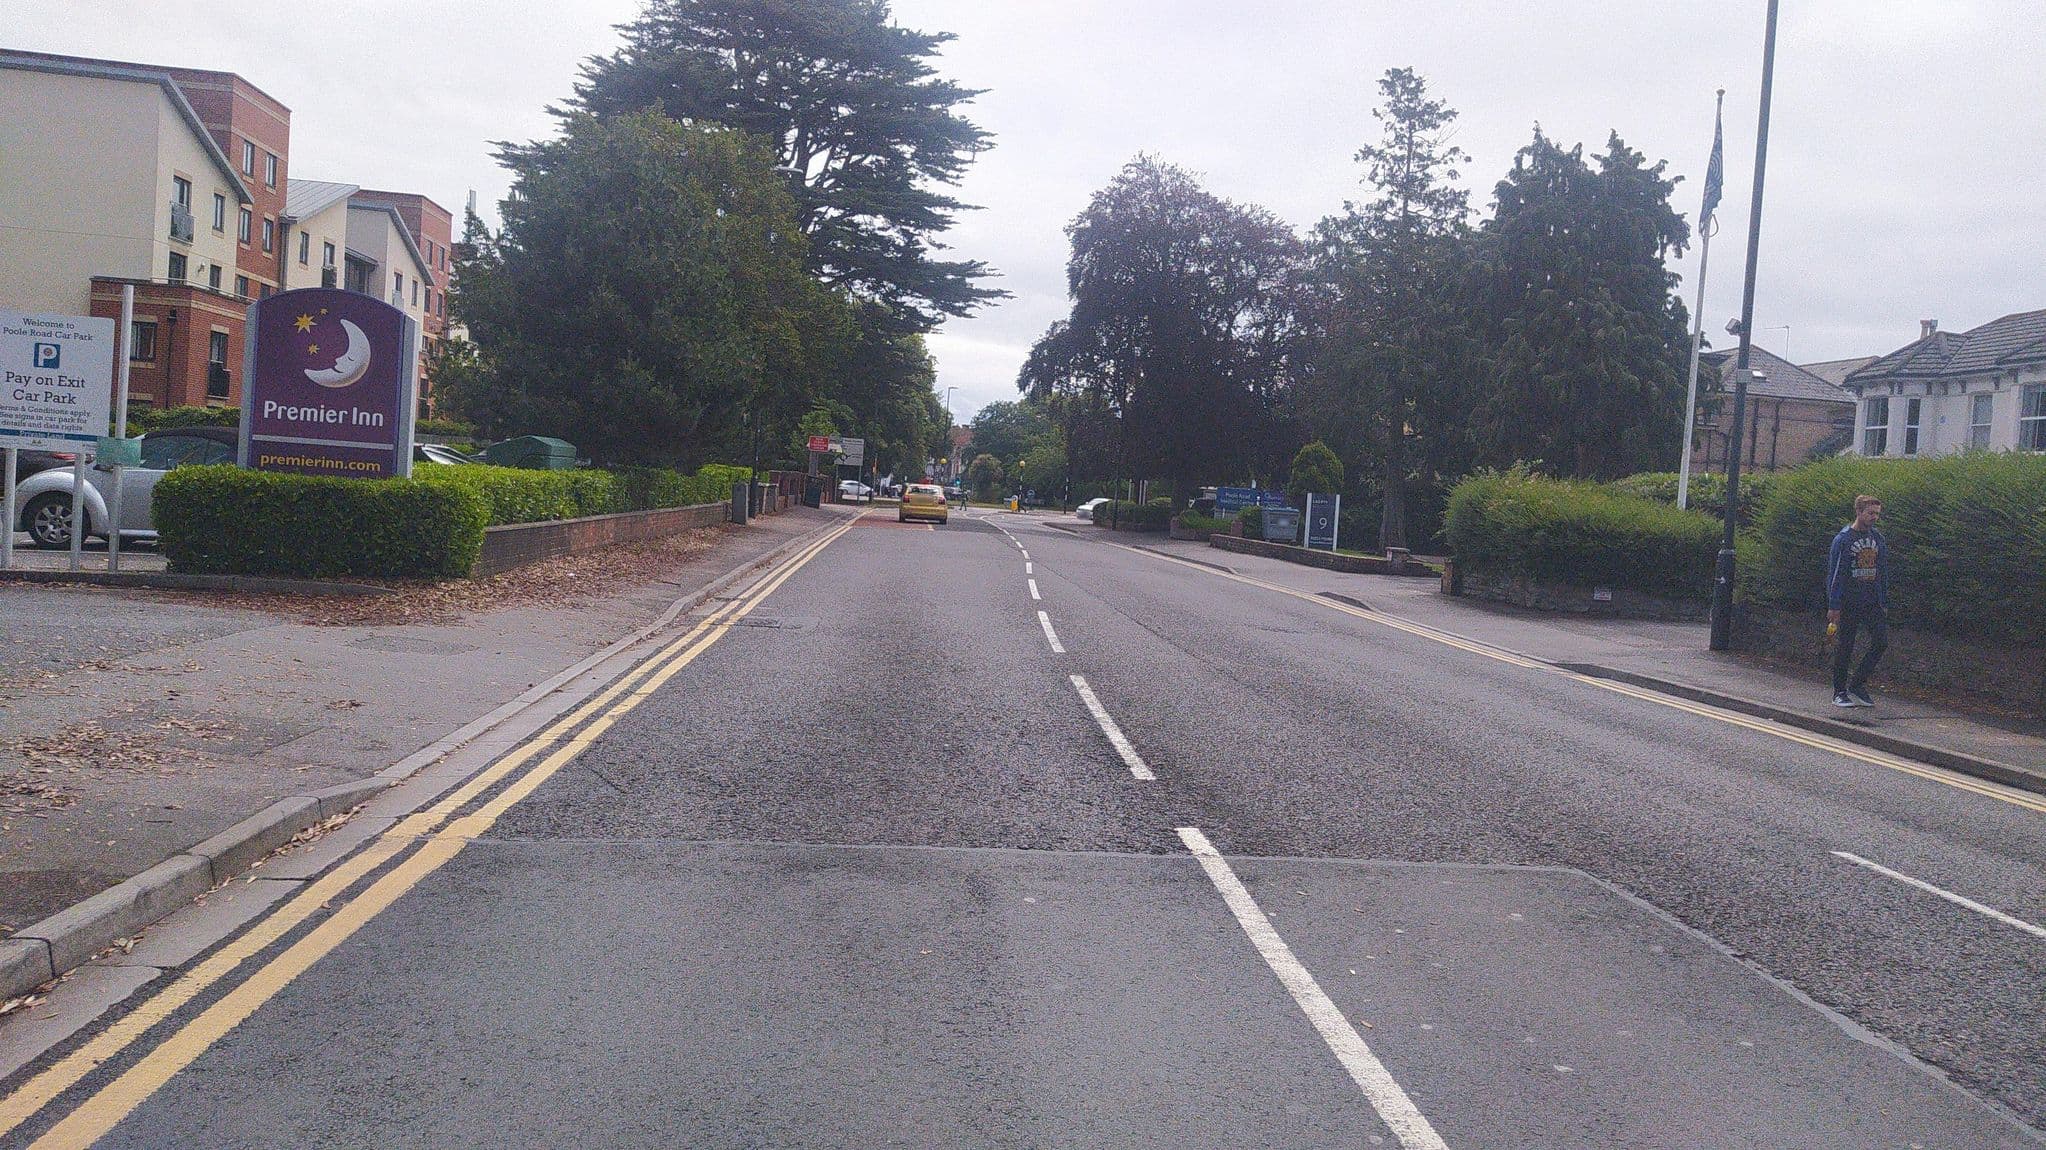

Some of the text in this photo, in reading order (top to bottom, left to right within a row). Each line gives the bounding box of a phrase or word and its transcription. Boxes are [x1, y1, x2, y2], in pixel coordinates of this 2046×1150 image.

[23, 318, 75, 330] Welcome to
[3, 327, 93, 341] Poole Road Car Park
[5, 371, 86, 388] Pay on Exit
[13, 389, 77, 404] Car Park
[15, 412, 36, 420] signs
[28, 406, 68, 415] Conditions
[263, 400, 384, 427] Premier Inn
[28, 421, 42, 429] and
[260, 454, 381, 472] premierinn.com
[1319, 517, 1328, 530] 9
